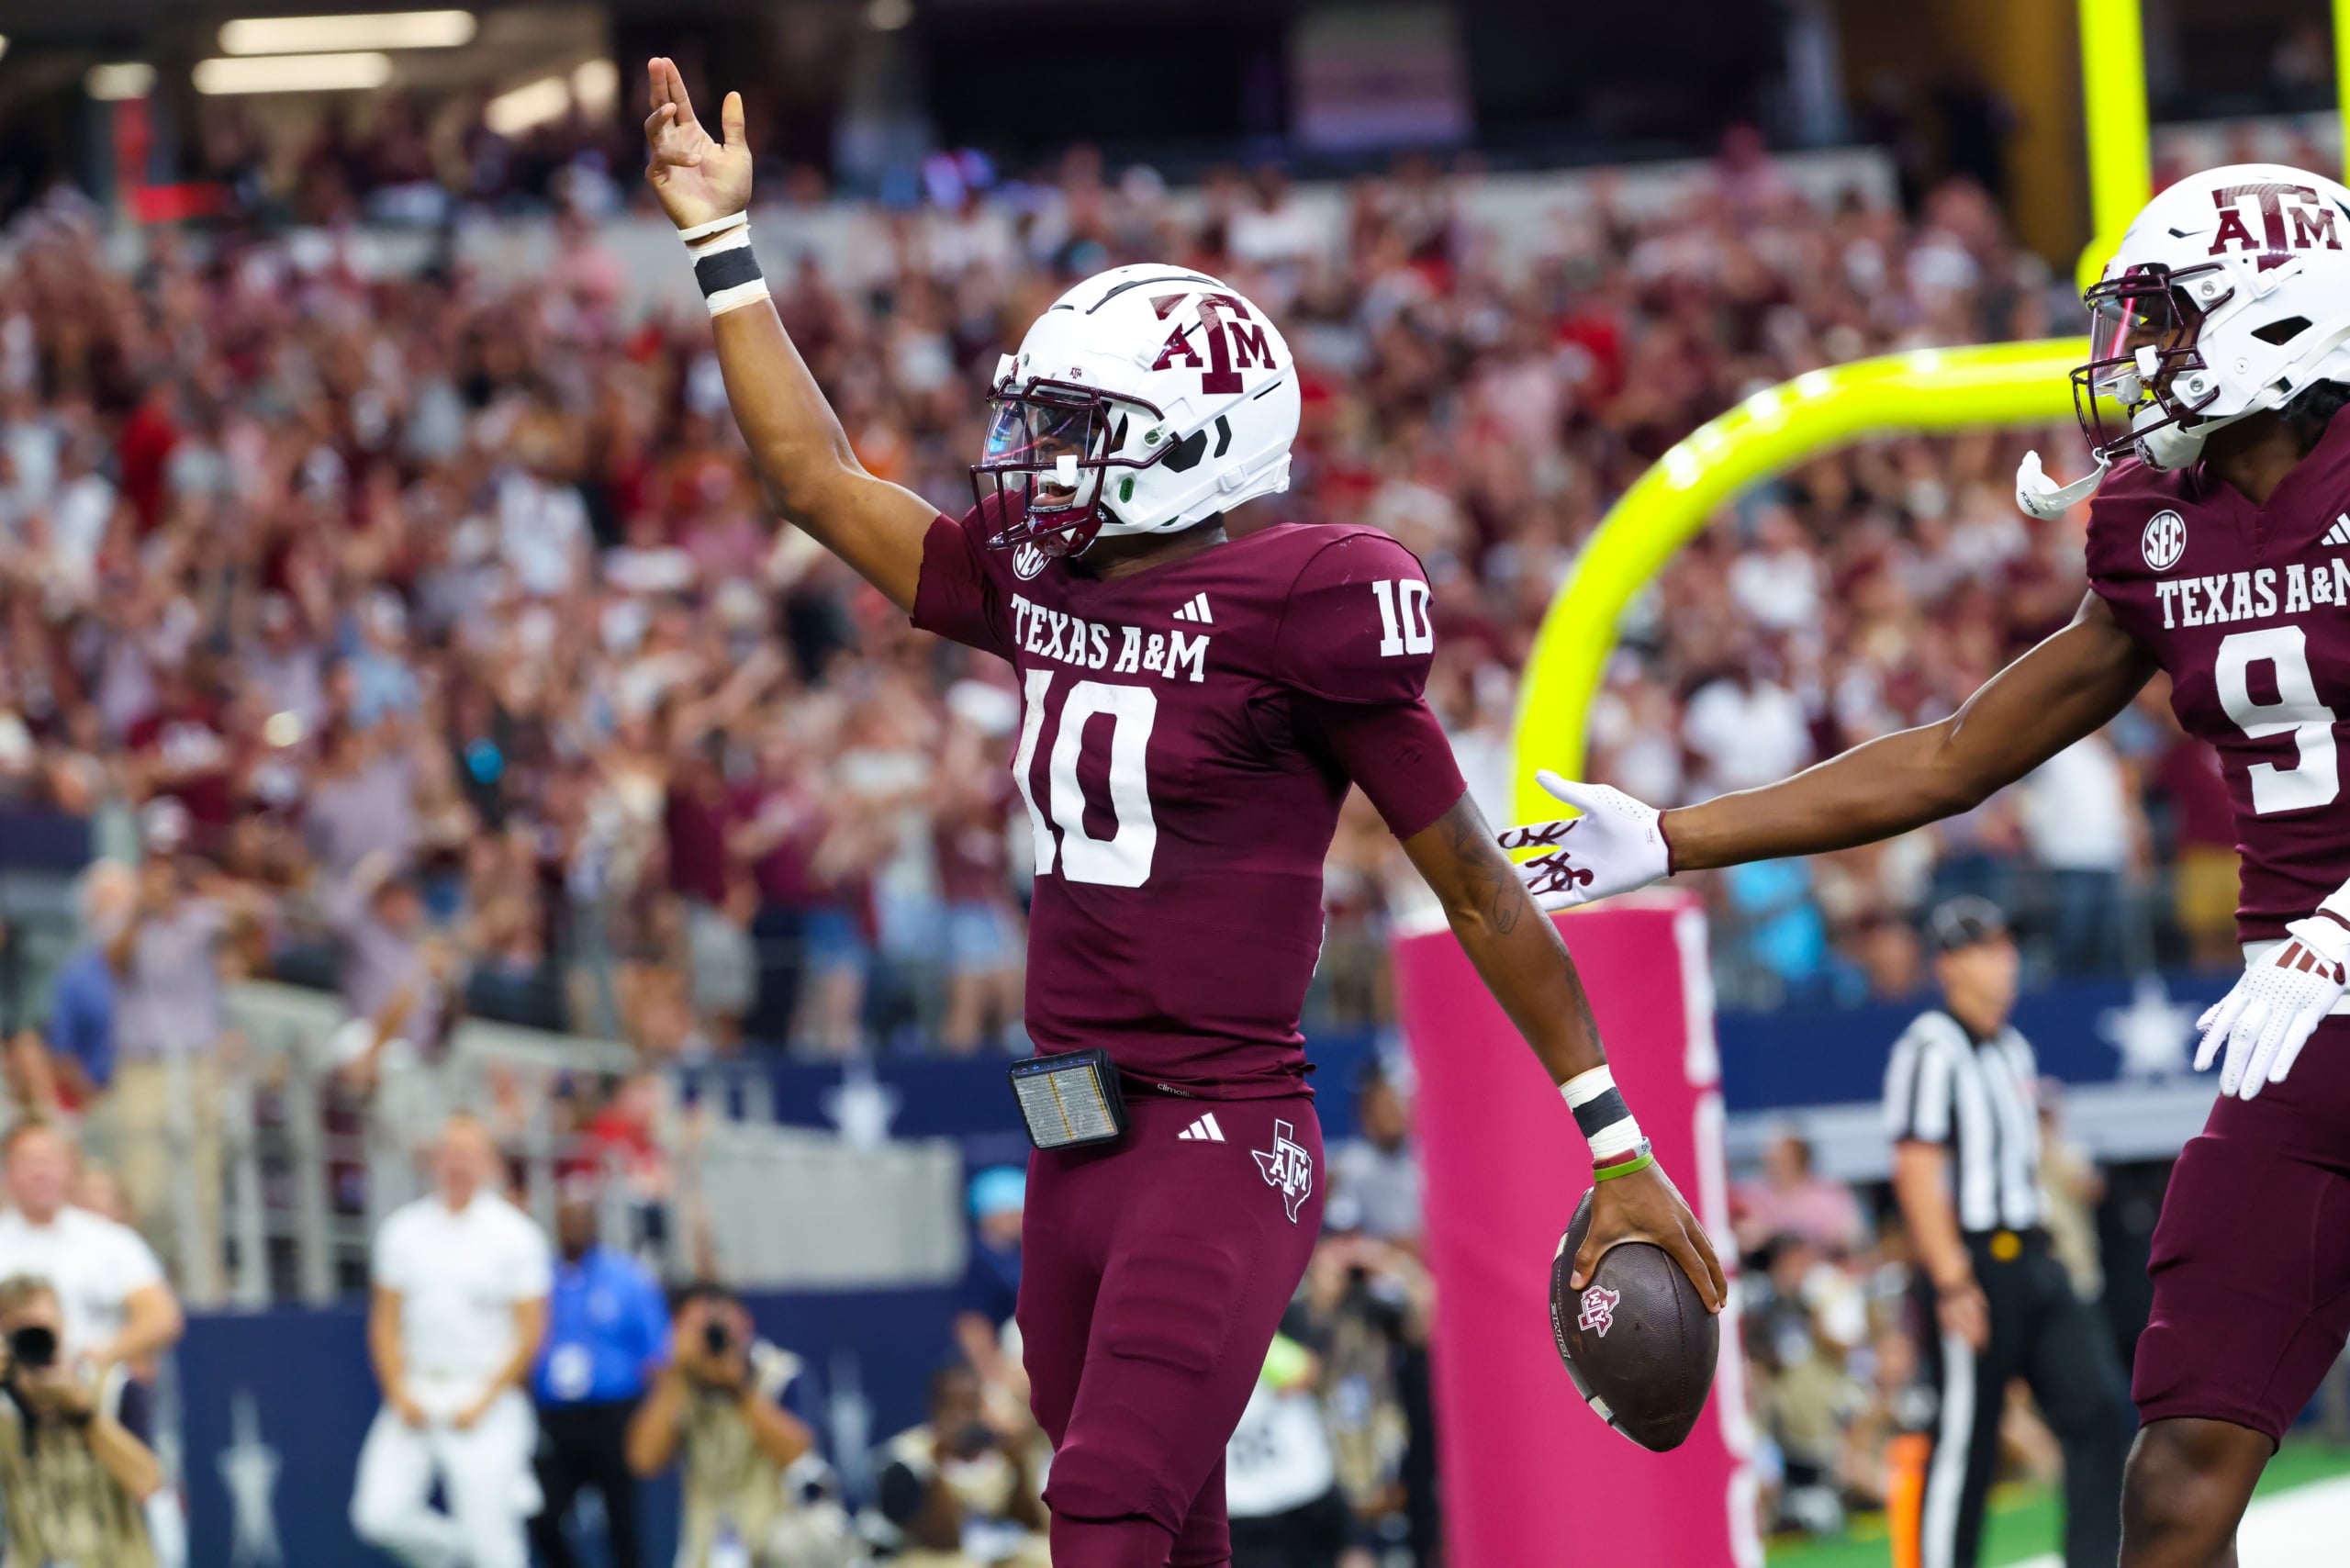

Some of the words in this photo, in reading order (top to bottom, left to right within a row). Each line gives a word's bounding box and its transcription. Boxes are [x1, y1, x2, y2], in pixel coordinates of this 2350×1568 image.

[2146, 514, 2182, 566] SEC
[1011, 593, 1109, 669] TEXAS
[1113, 626, 1211, 683] A&M
[1371, 578, 1434, 657] 10
[2155, 568, 2277, 630] TEXAS
[2214, 625, 2340, 815] 9
[1012, 668, 1158, 888] 10
